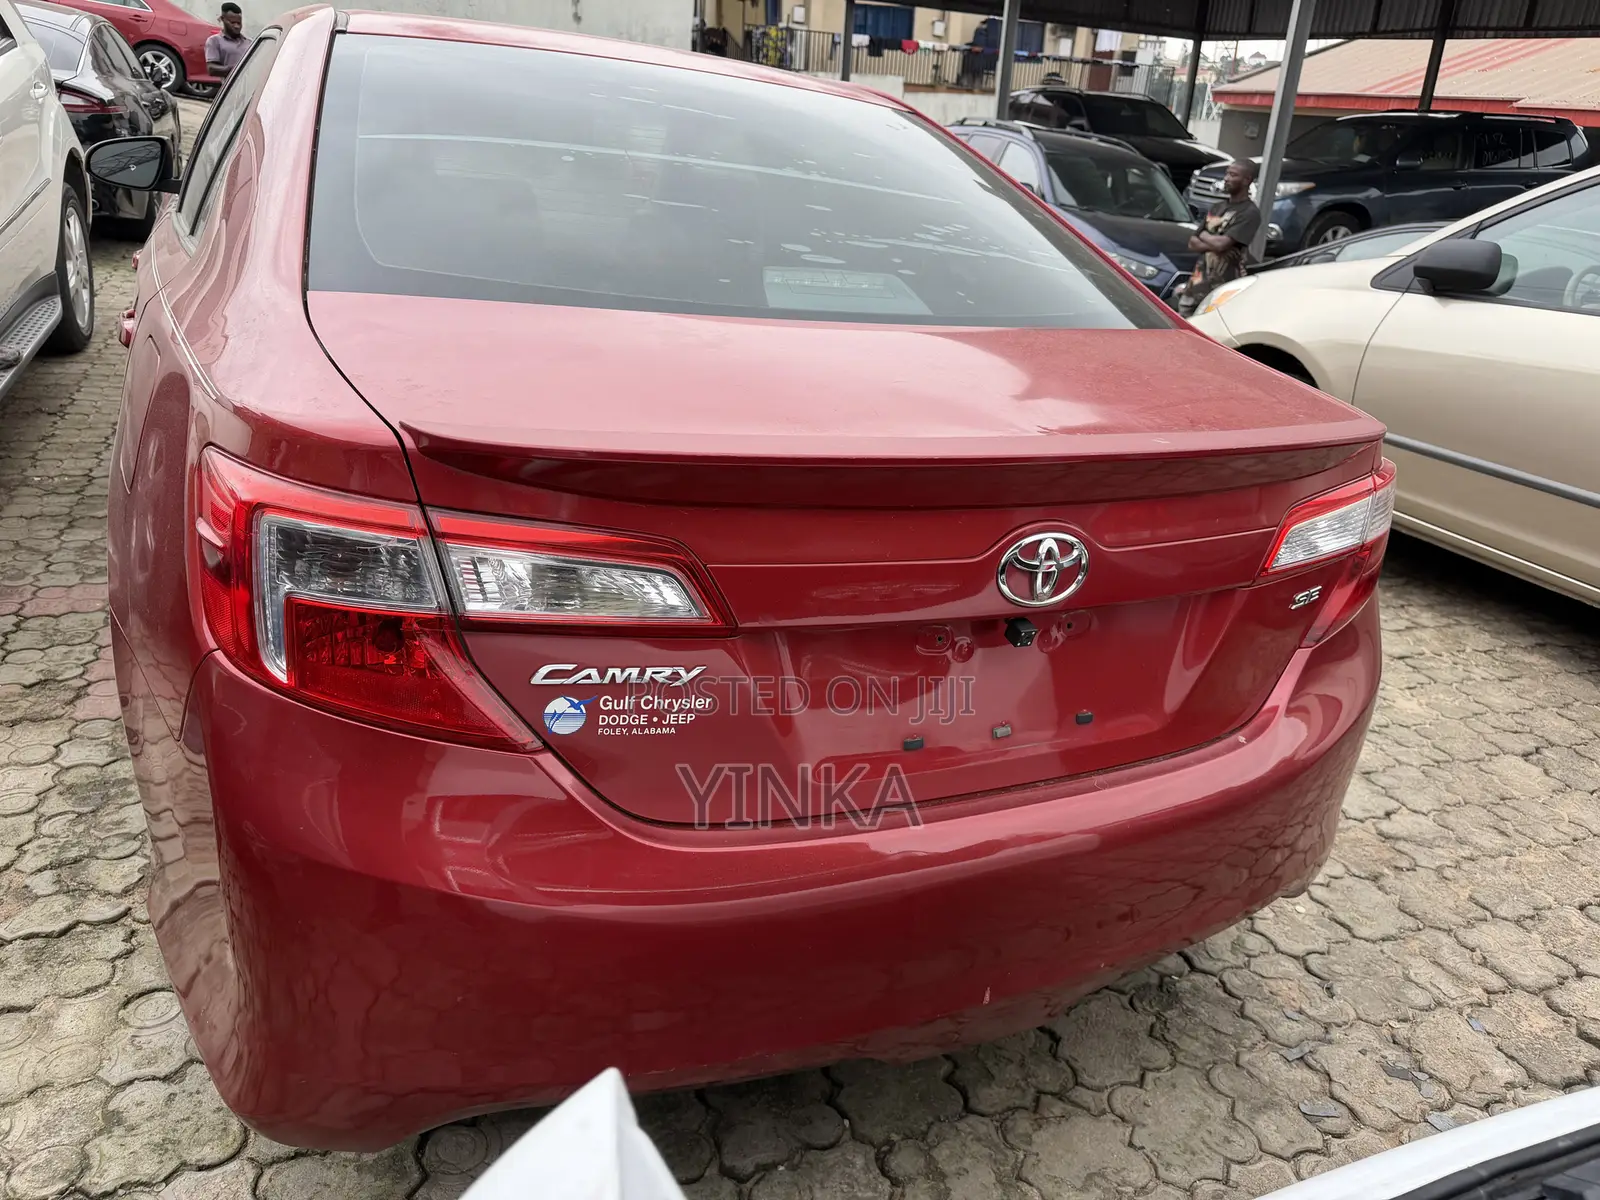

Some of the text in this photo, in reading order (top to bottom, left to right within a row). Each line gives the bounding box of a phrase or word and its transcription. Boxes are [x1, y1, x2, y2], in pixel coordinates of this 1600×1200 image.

[1289, 586, 1322, 610] SE
[530, 663, 707, 687] CAMRY
[599, 695, 712, 713] Gulf Chrysler
[599, 713, 695, 726] DODGE JEEP
[598, 727, 676, 736] FOLEY, ALABAMA
